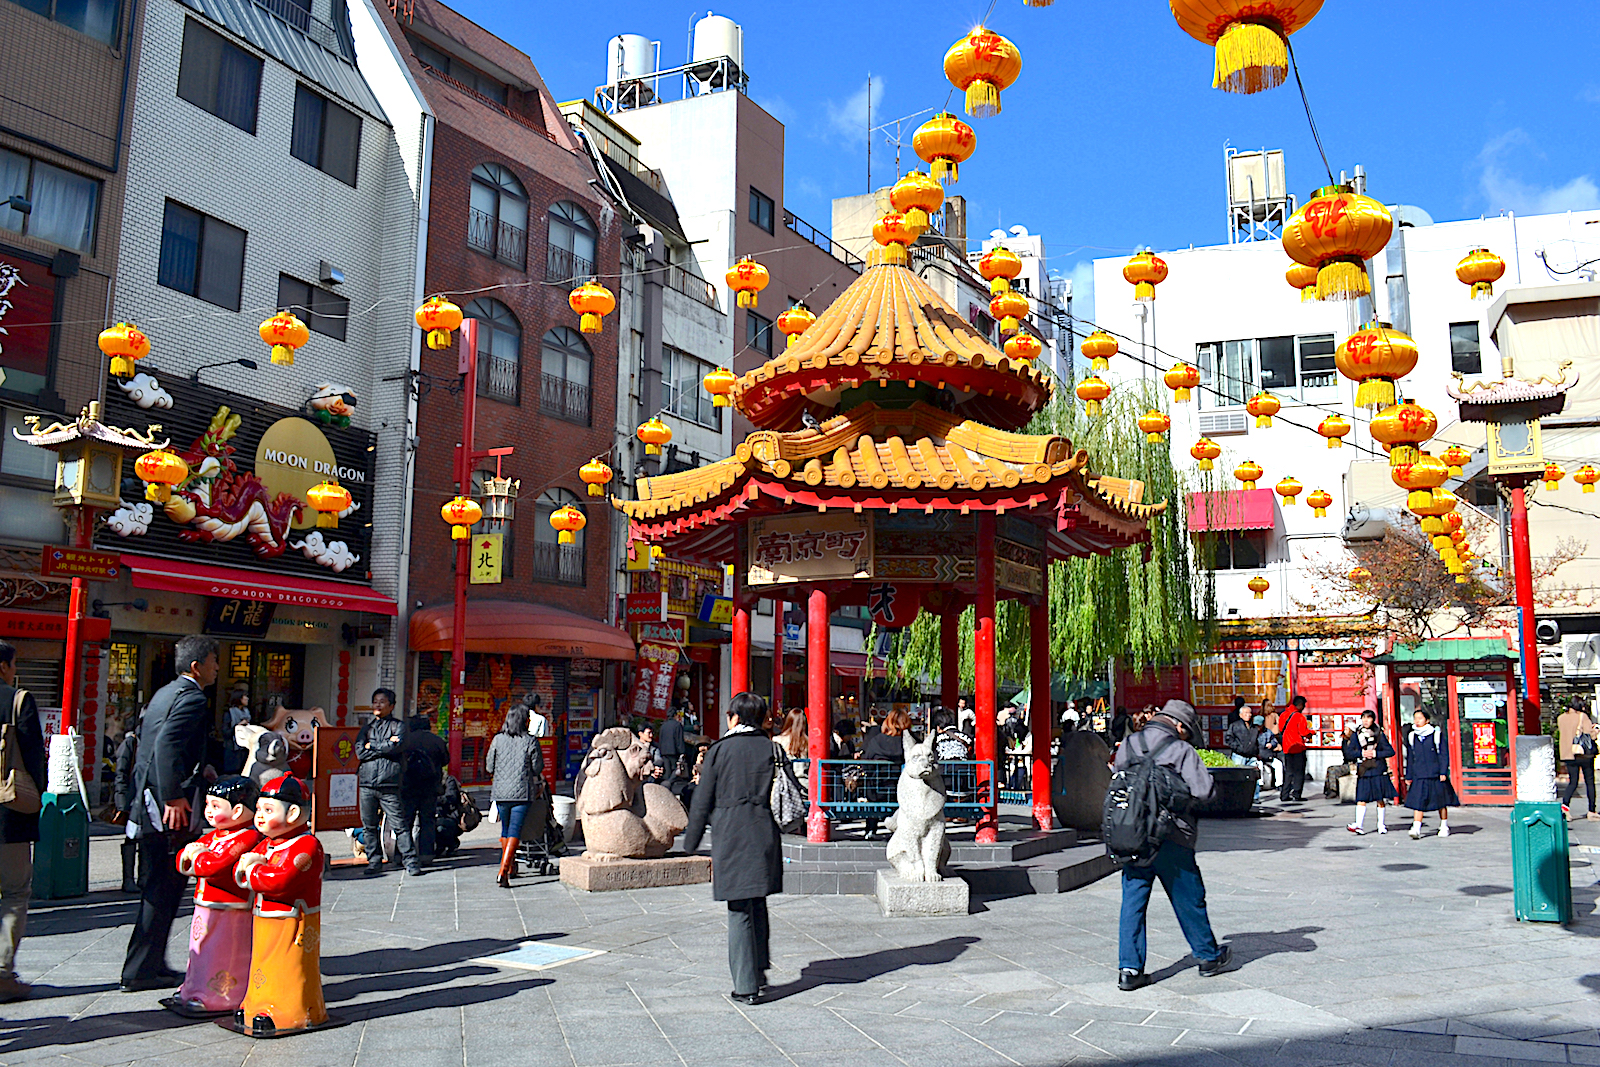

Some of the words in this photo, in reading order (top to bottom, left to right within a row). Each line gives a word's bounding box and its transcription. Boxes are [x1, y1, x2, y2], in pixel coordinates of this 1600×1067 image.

[264, 448, 308, 469] MOON
[314, 460, 365, 482] DRAGON
[65, 552, 115, 565] 観光トイレ
[477, 551, 495, 569] 北
[756, 529, 867, 567] 南京町
[242, 589, 273, 599] MOON
[278, 593, 319, 604] DRAGON
[652, 663, 674, 710] 中華料理
